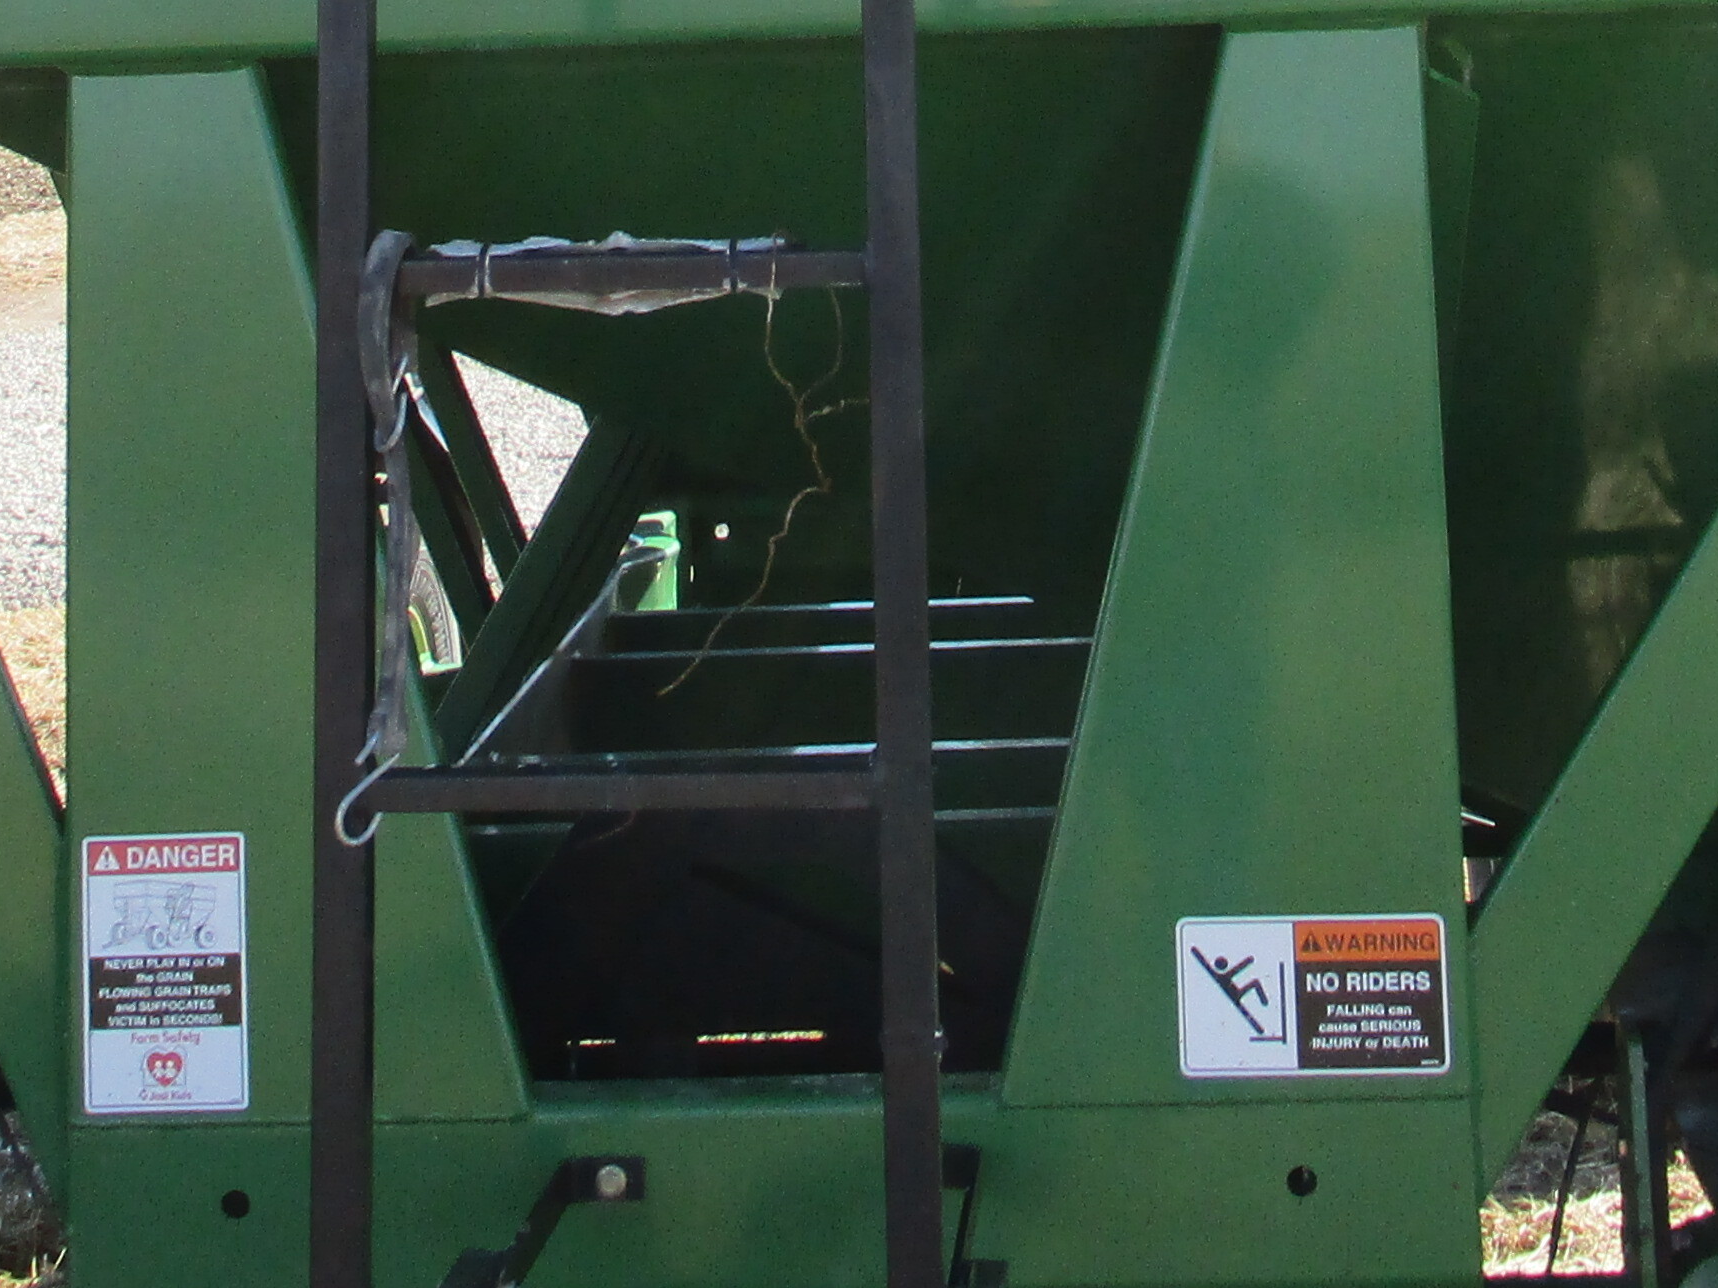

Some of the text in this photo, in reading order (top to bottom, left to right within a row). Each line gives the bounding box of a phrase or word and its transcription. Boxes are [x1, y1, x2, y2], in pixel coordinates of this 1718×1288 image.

[126, 843, 236, 870] DANGER
[1324, 932, 1435, 953] WARNING
[103, 956, 226, 970] NEVER PLAY IN or ON
[135, 971, 194, 984] the GRAIN
[1305, 970, 1431, 993] NO RIDERS
[98, 984, 232, 999] FLOWING GRAIN TRAPS
[115, 999, 216, 1013] and SUFFOCATES
[1326, 1004, 1412, 1017] FALLING can
[107, 1015, 147, 1027] VICTIM
[162, 1013, 223, 1025] SECONDS!
[1318, 1019, 1422, 1034] cause SERIOUS
[130, 1030, 202, 1046] Farm Safety
[1311, 1035, 1430, 1050] INJURY or DEATH
